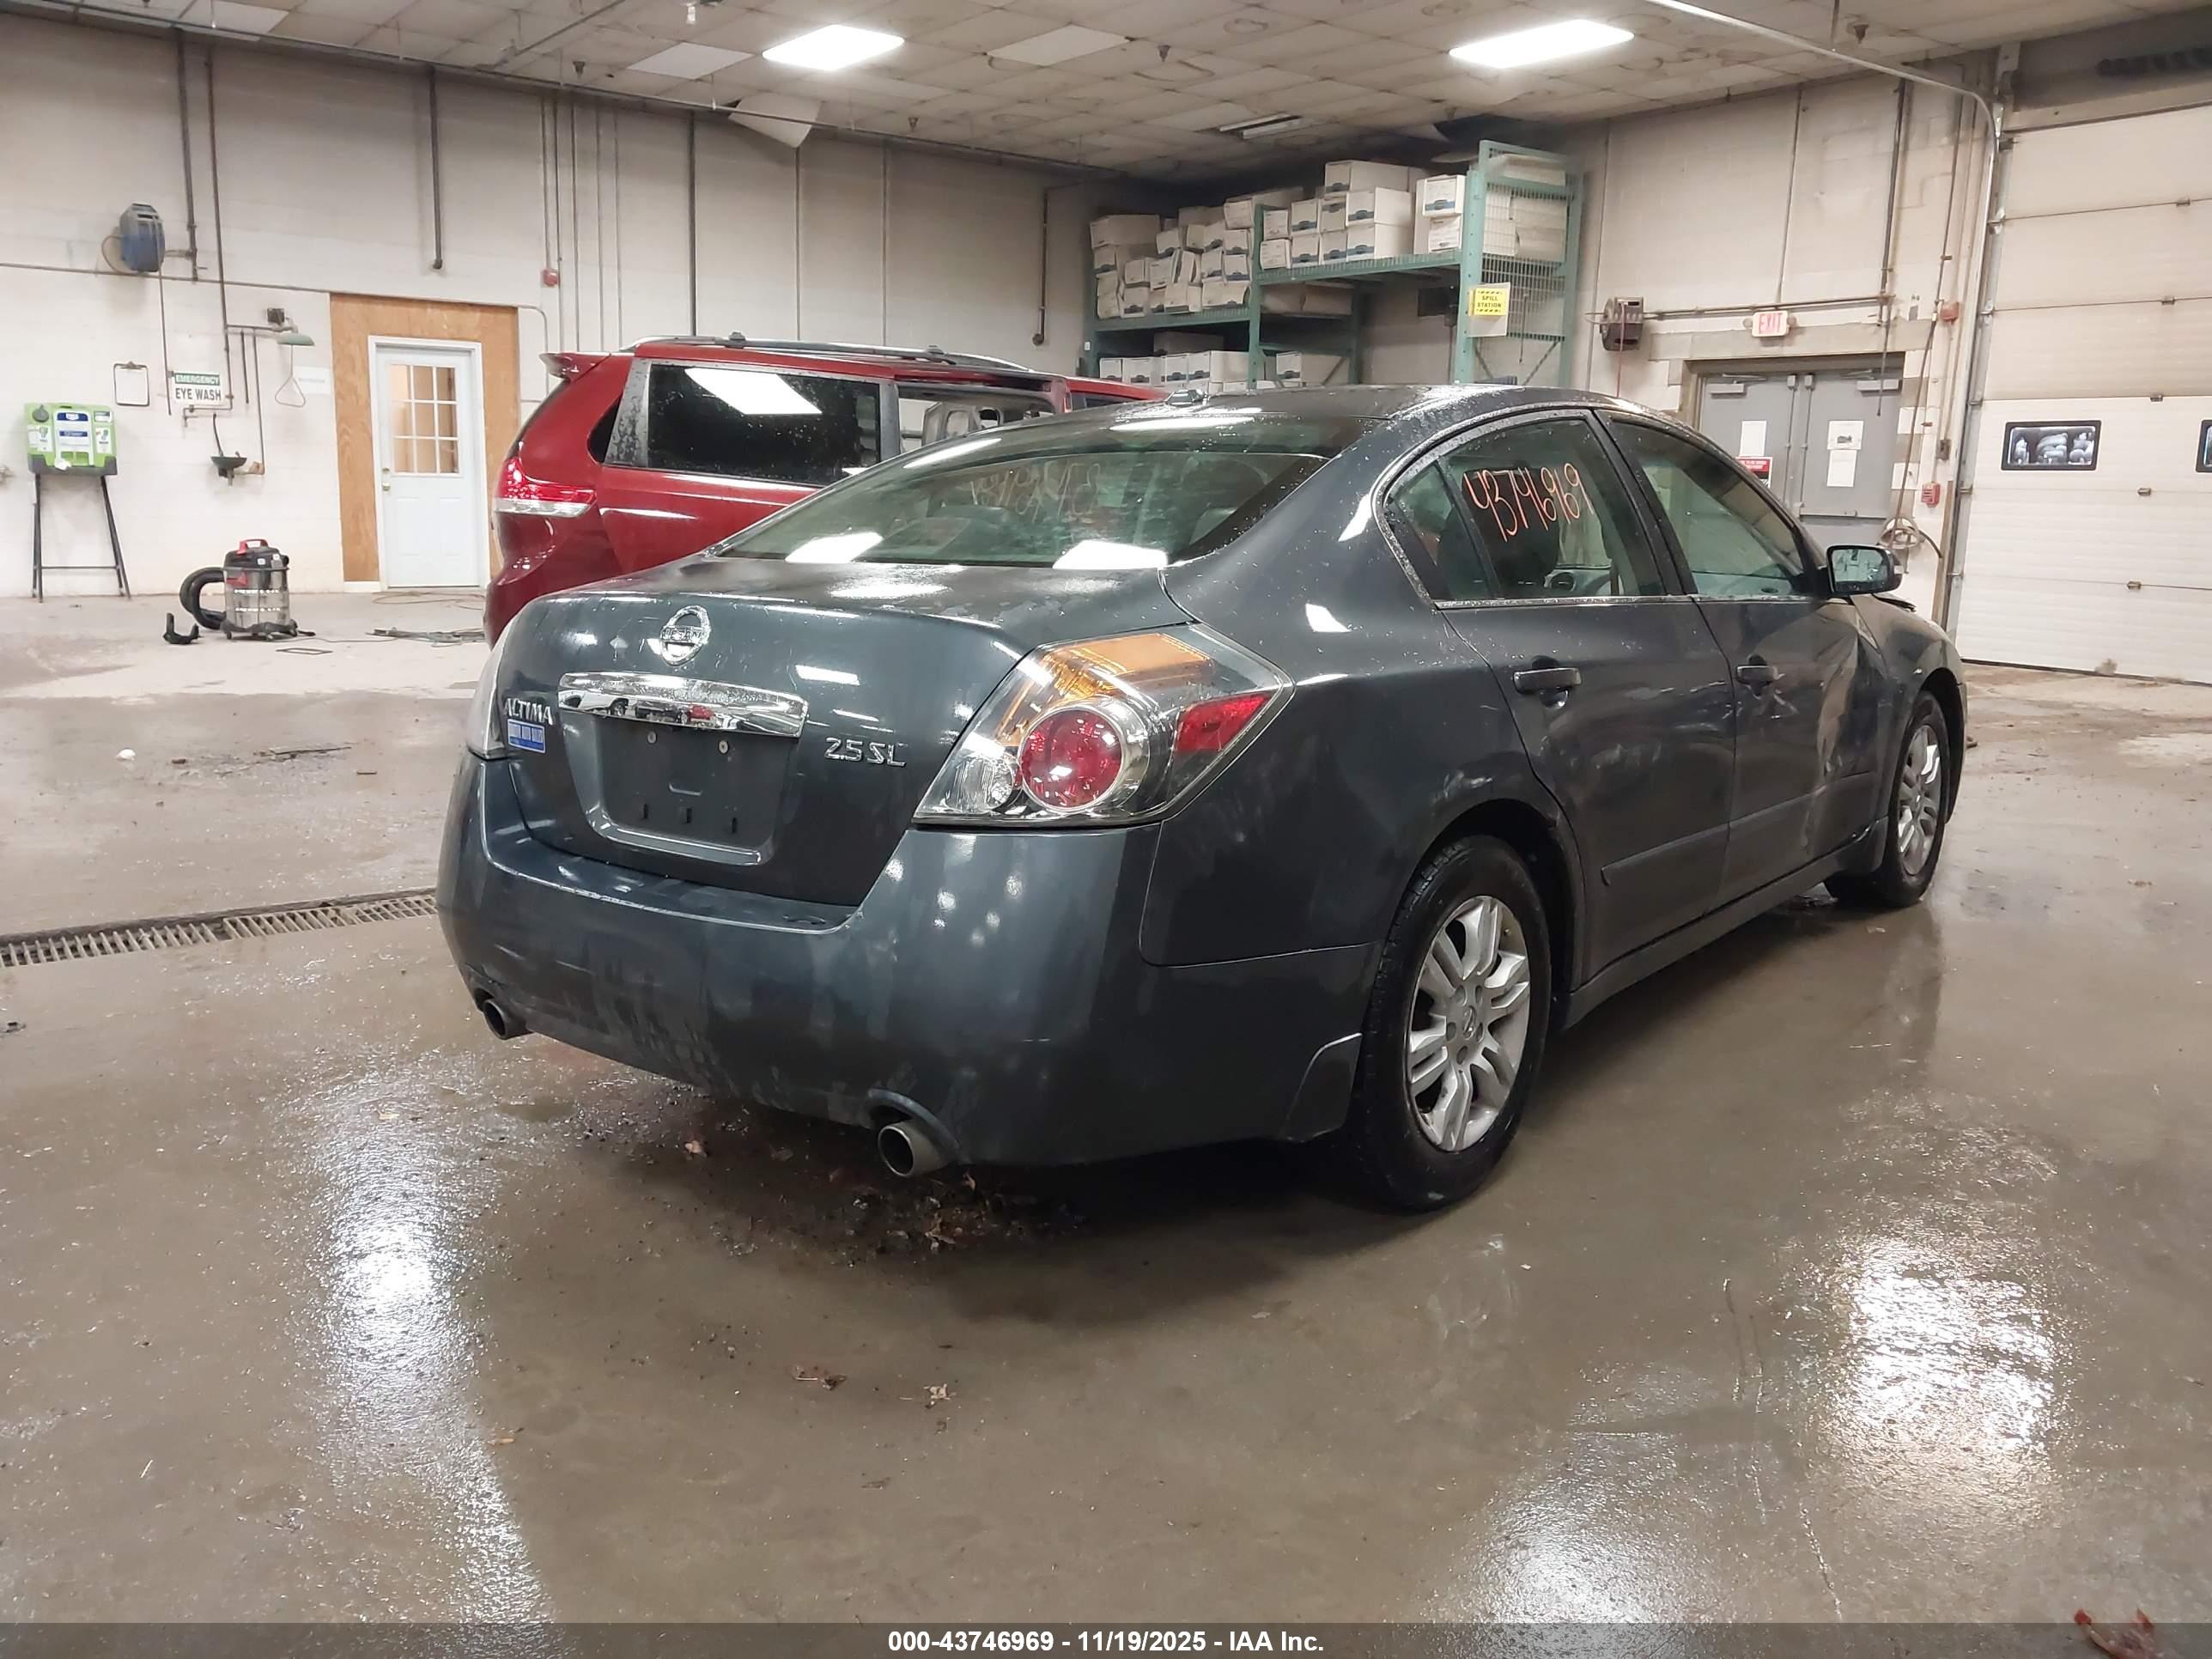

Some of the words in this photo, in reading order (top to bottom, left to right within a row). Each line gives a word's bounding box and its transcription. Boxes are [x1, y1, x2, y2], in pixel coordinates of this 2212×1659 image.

[1759, 313, 1783, 334] EXIT
[175, 374, 219, 384] EMERGENCY
[175, 387, 193, 400] EYE
[195, 389, 222, 401] WASH
[1463, 463, 1595, 542] 43746969
[503, 698, 554, 726] ALTIMA
[866, 742, 907, 768] SL
